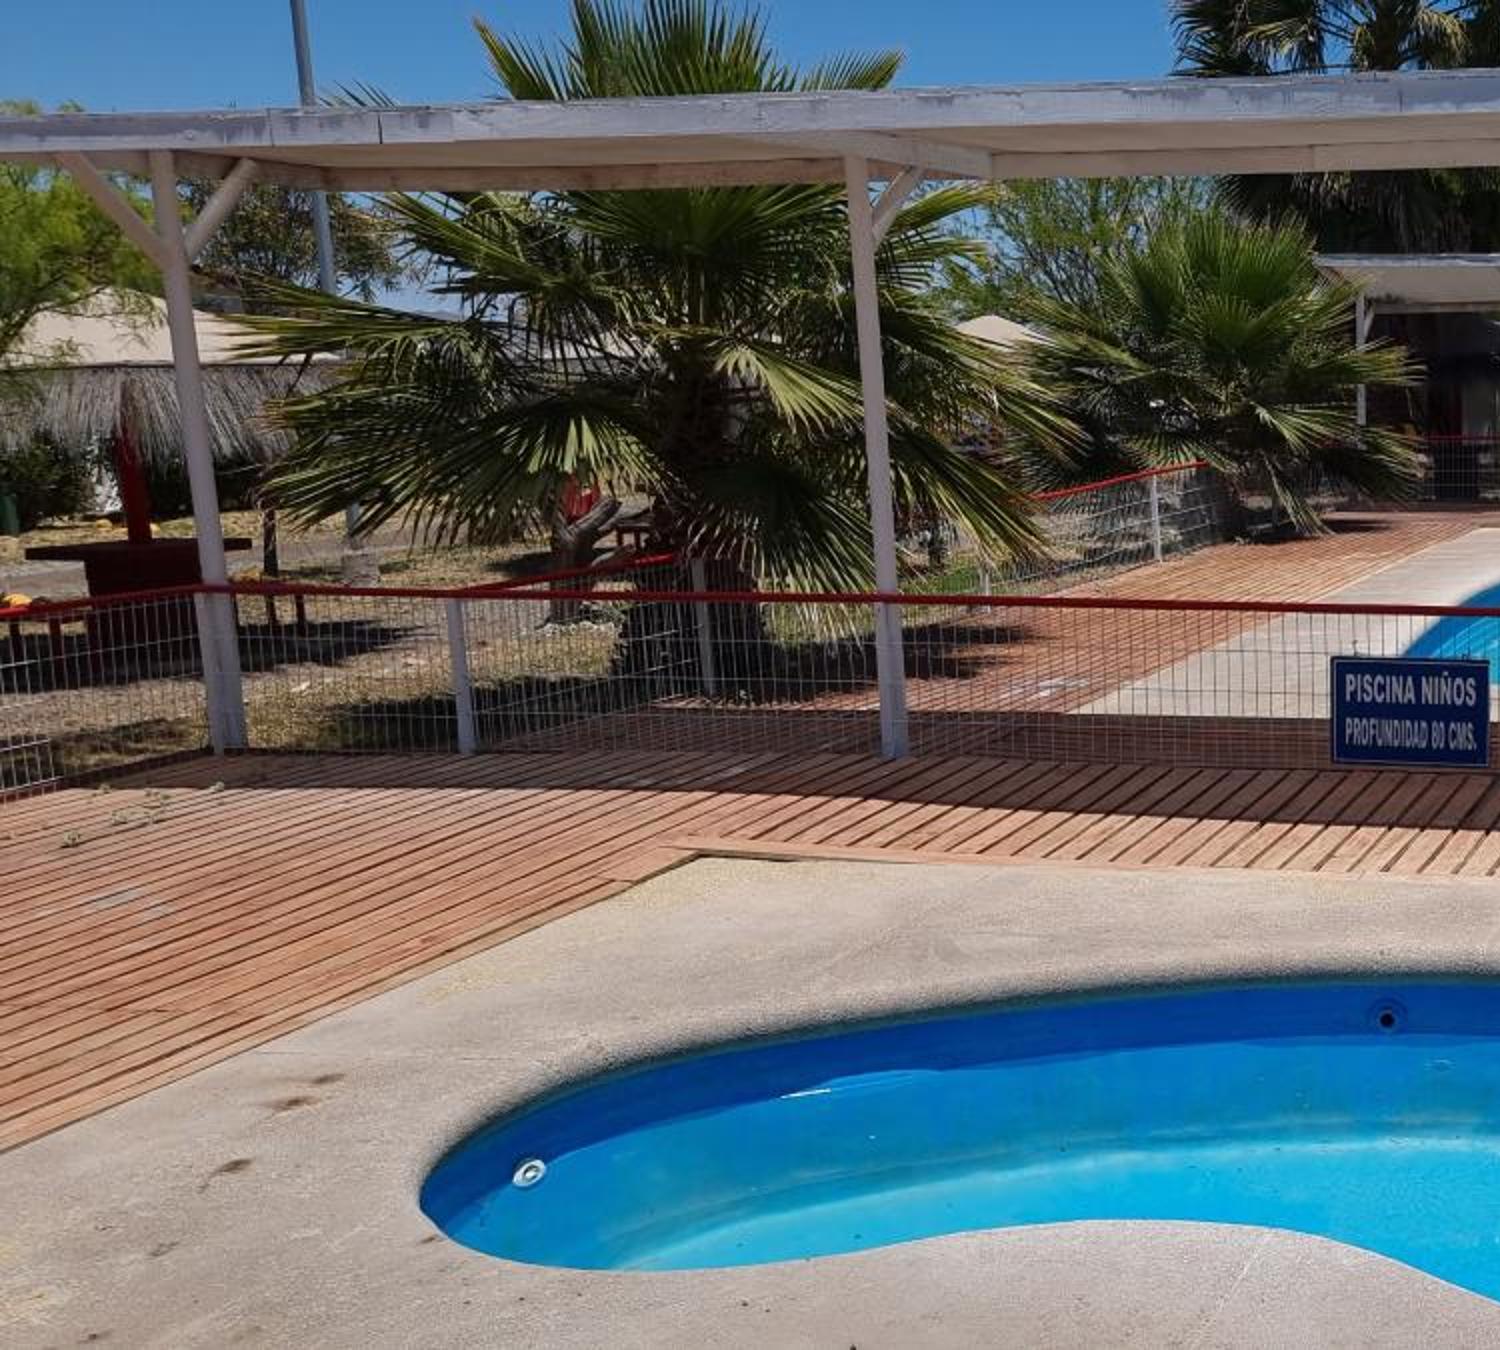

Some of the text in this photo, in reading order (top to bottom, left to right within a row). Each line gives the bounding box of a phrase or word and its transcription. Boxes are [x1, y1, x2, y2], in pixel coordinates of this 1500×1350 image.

[1345, 671, 1477, 706] PISCINA NIÑOS
[1345, 716, 1429, 748] PROFUNDIDAD
[1431, 719, 1446, 749] 80
